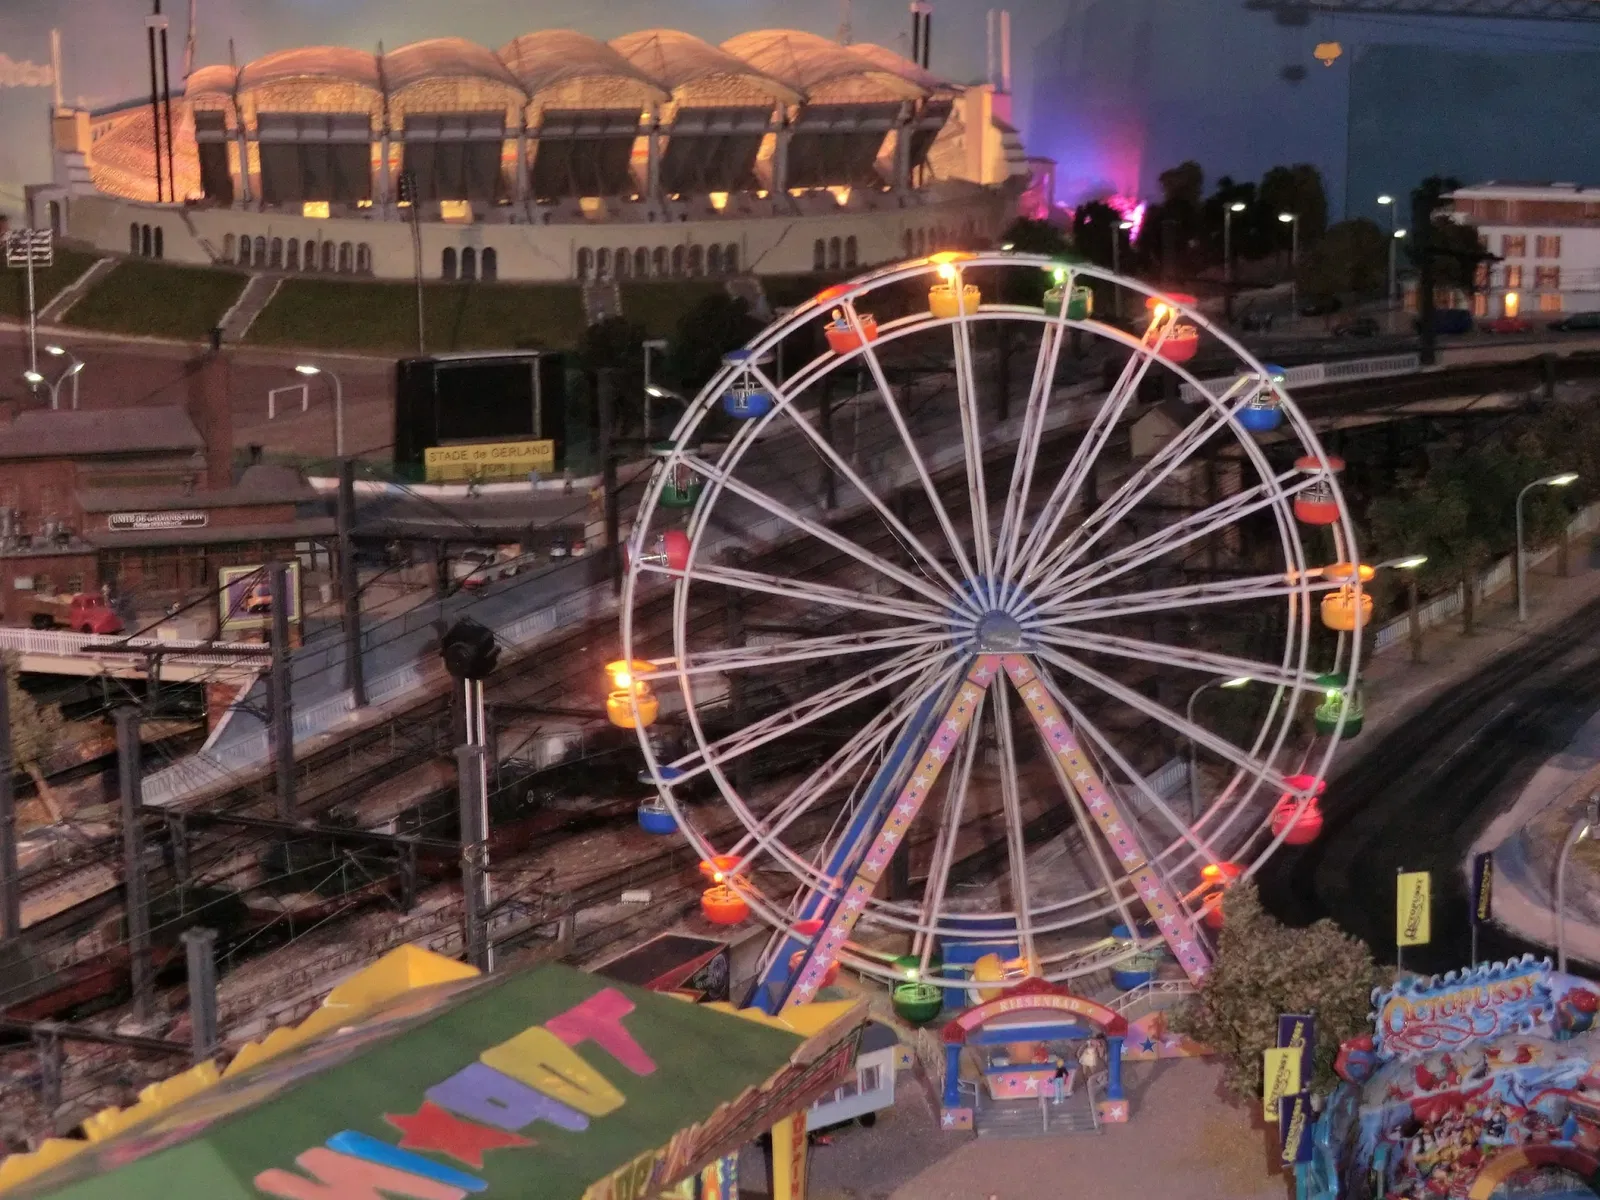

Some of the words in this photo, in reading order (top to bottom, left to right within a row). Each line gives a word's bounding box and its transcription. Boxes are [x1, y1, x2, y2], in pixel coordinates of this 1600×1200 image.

[429, 450, 469, 463] STADE
[473, 450, 487, 460] de
[491, 445, 550, 459] GERLAND
[999, 996, 1080, 1011] RIESENRAD
